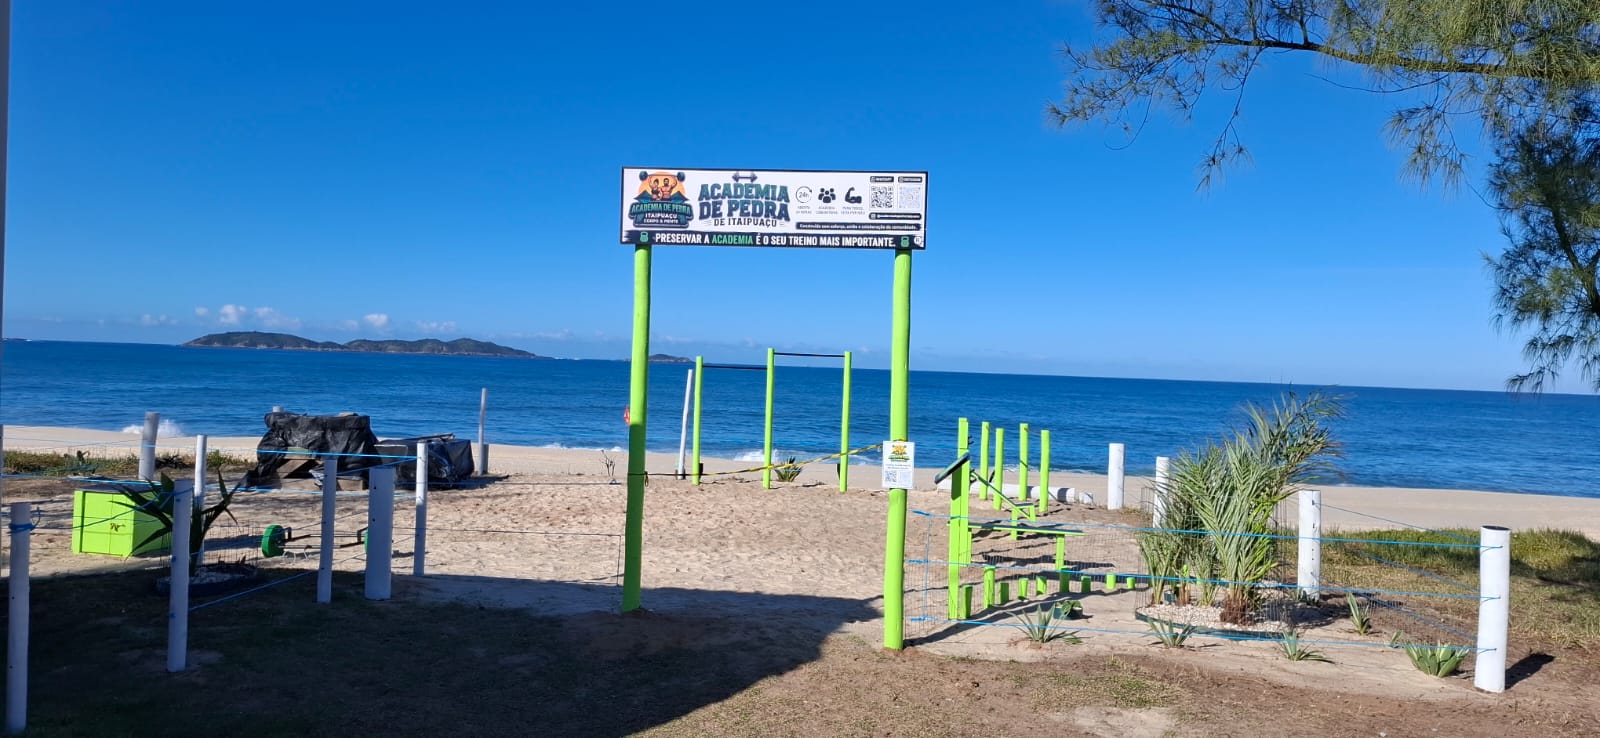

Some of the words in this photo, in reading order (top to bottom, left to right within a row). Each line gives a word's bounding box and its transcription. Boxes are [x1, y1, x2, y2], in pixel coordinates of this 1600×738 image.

[698, 183, 790, 203] ACADEMIA
[799, 191, 810, 199] 24h
[632, 203, 663, 213] ACADEMIA
[663, 203, 672, 211] DE
[699, 201, 723, 220] DE
[727, 200, 791, 222] PEDRA
[714, 218, 725, 227] DE
[728, 218, 777, 228] ITAIPUAÇU
[655, 233, 702, 244] PRESERVAR
[703, 234, 710, 244] A
[711, 234, 753, 245] ACADEMIA
[756, 232, 762, 245] É
[763, 235, 769, 245] O
[771, 235, 787, 245] SEU
[789, 236, 818, 246] TREINO
[819, 236, 840, 246] MAIS
[841, 236, 896, 247] IMPORTANTE.
